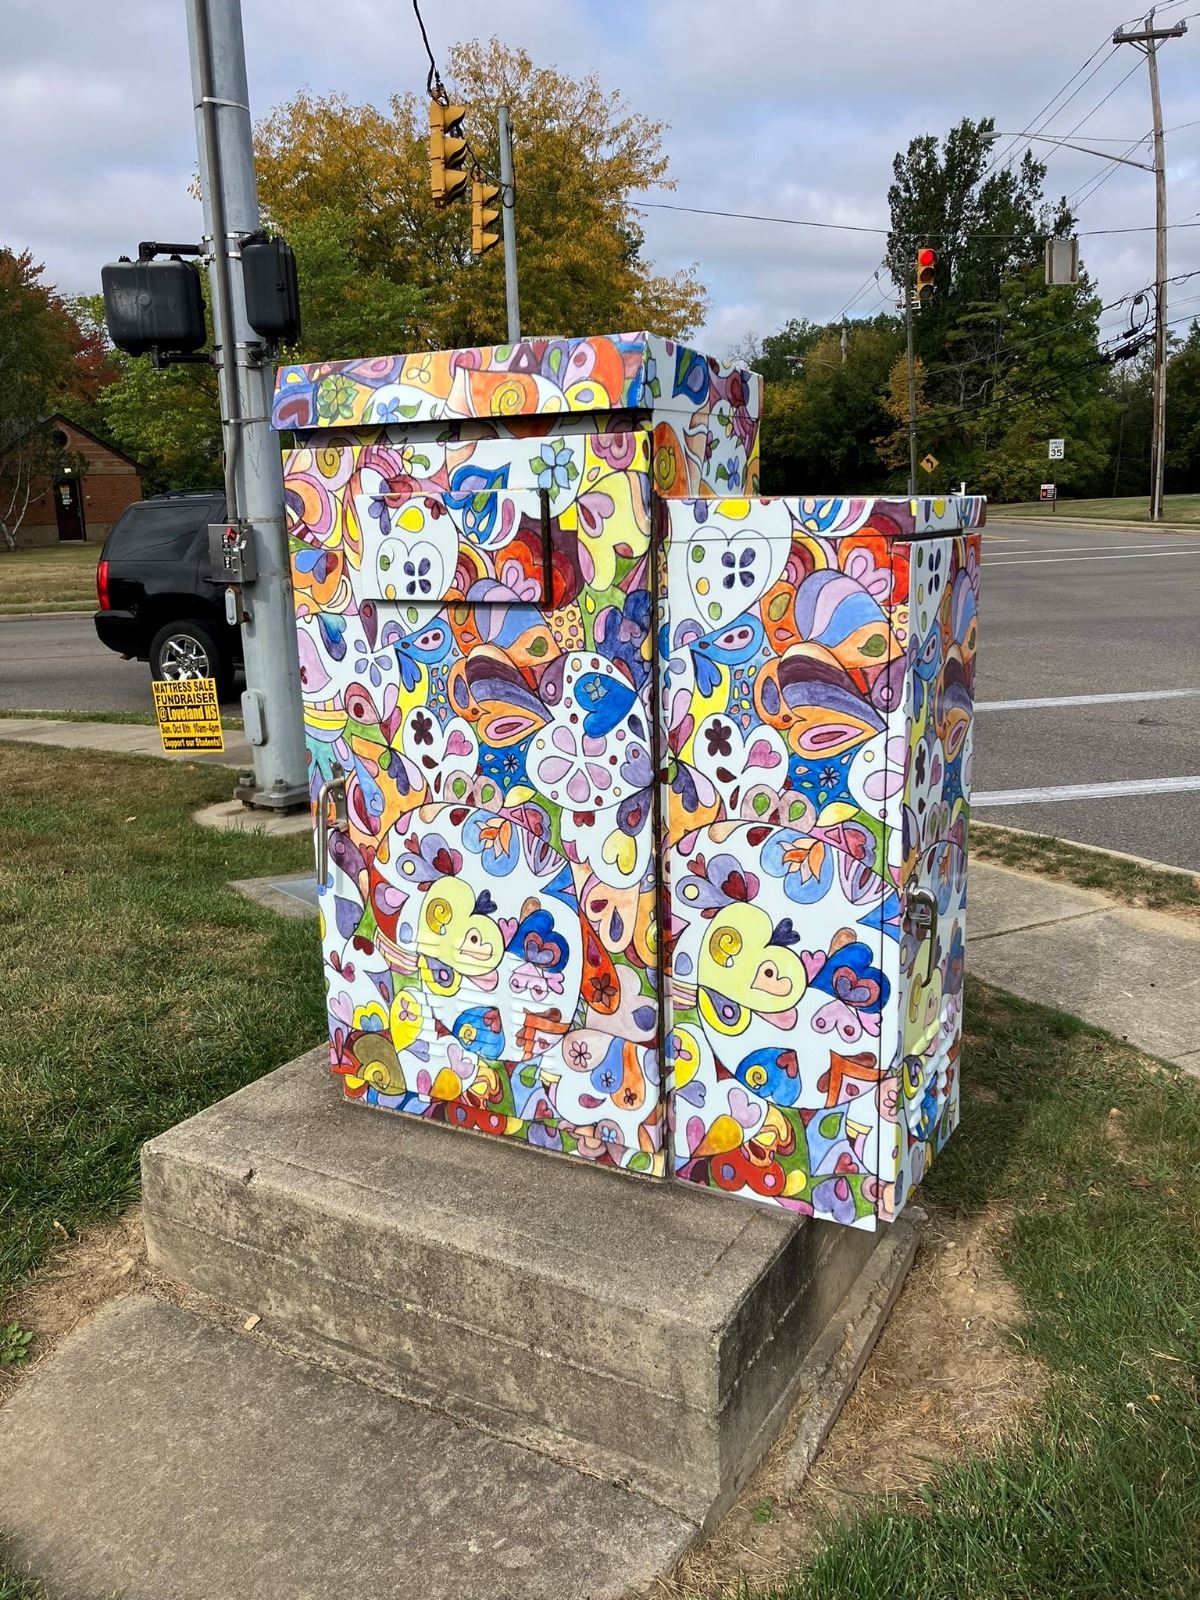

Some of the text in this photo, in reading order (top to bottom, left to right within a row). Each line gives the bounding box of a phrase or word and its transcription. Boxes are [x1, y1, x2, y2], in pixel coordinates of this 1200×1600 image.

[1051, 449, 1062, 457] 35
[153, 680, 214, 693] MATTRESS SALE
[155, 692, 216, 705] FUNDRAISER
[205, 705, 217, 720] HS
[172, 723, 182, 734] Oct
[164, 738, 185, 748] Support
[185, 739, 194, 747] our
